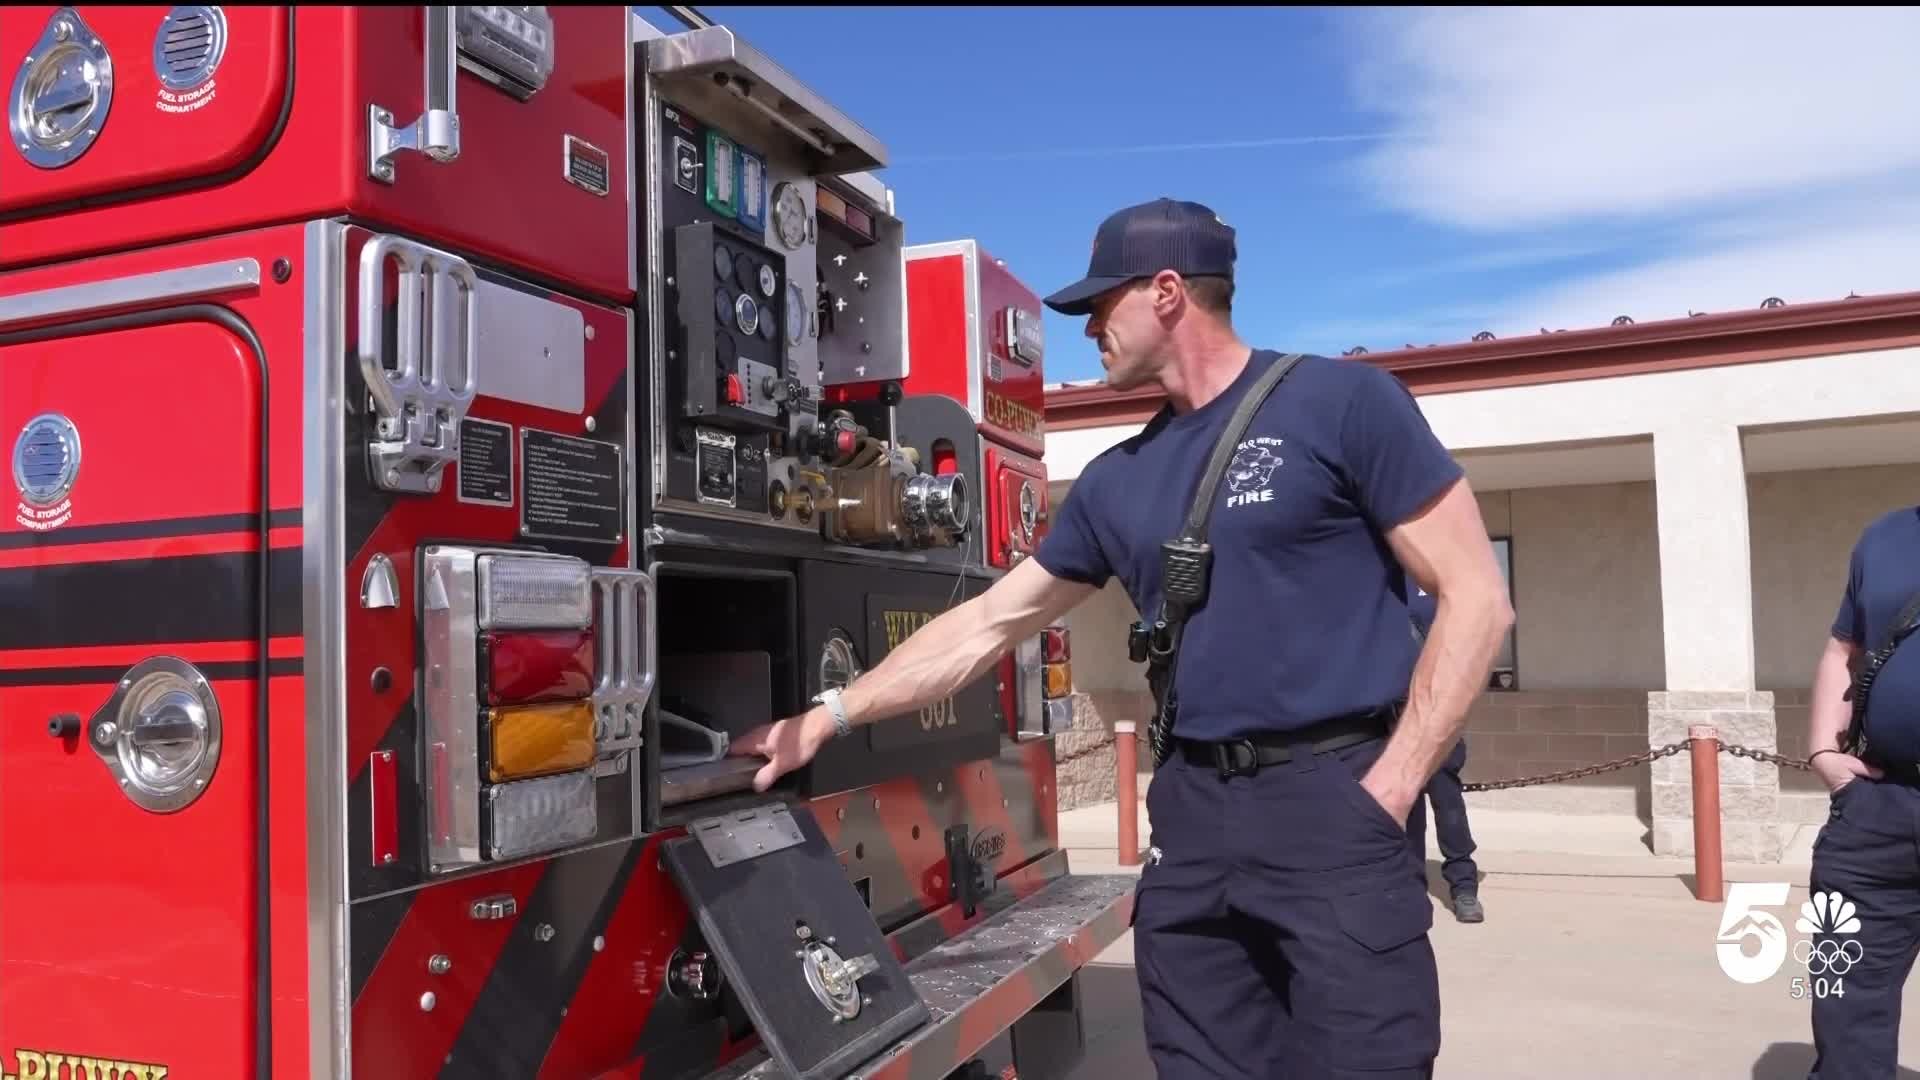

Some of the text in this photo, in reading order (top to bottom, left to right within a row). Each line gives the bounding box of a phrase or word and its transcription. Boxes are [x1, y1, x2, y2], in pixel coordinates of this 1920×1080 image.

[158, 79, 216, 103] FUEL STORAGE
[156, 89, 216, 113] COMPARTMENT
[1255, 437, 1284, 446] WEST
[1227, 489, 1275, 508] FIRE
[17, 499, 72, 519] FUEL STORAGE
[16, 510, 72, 529] COMPARTMENT
